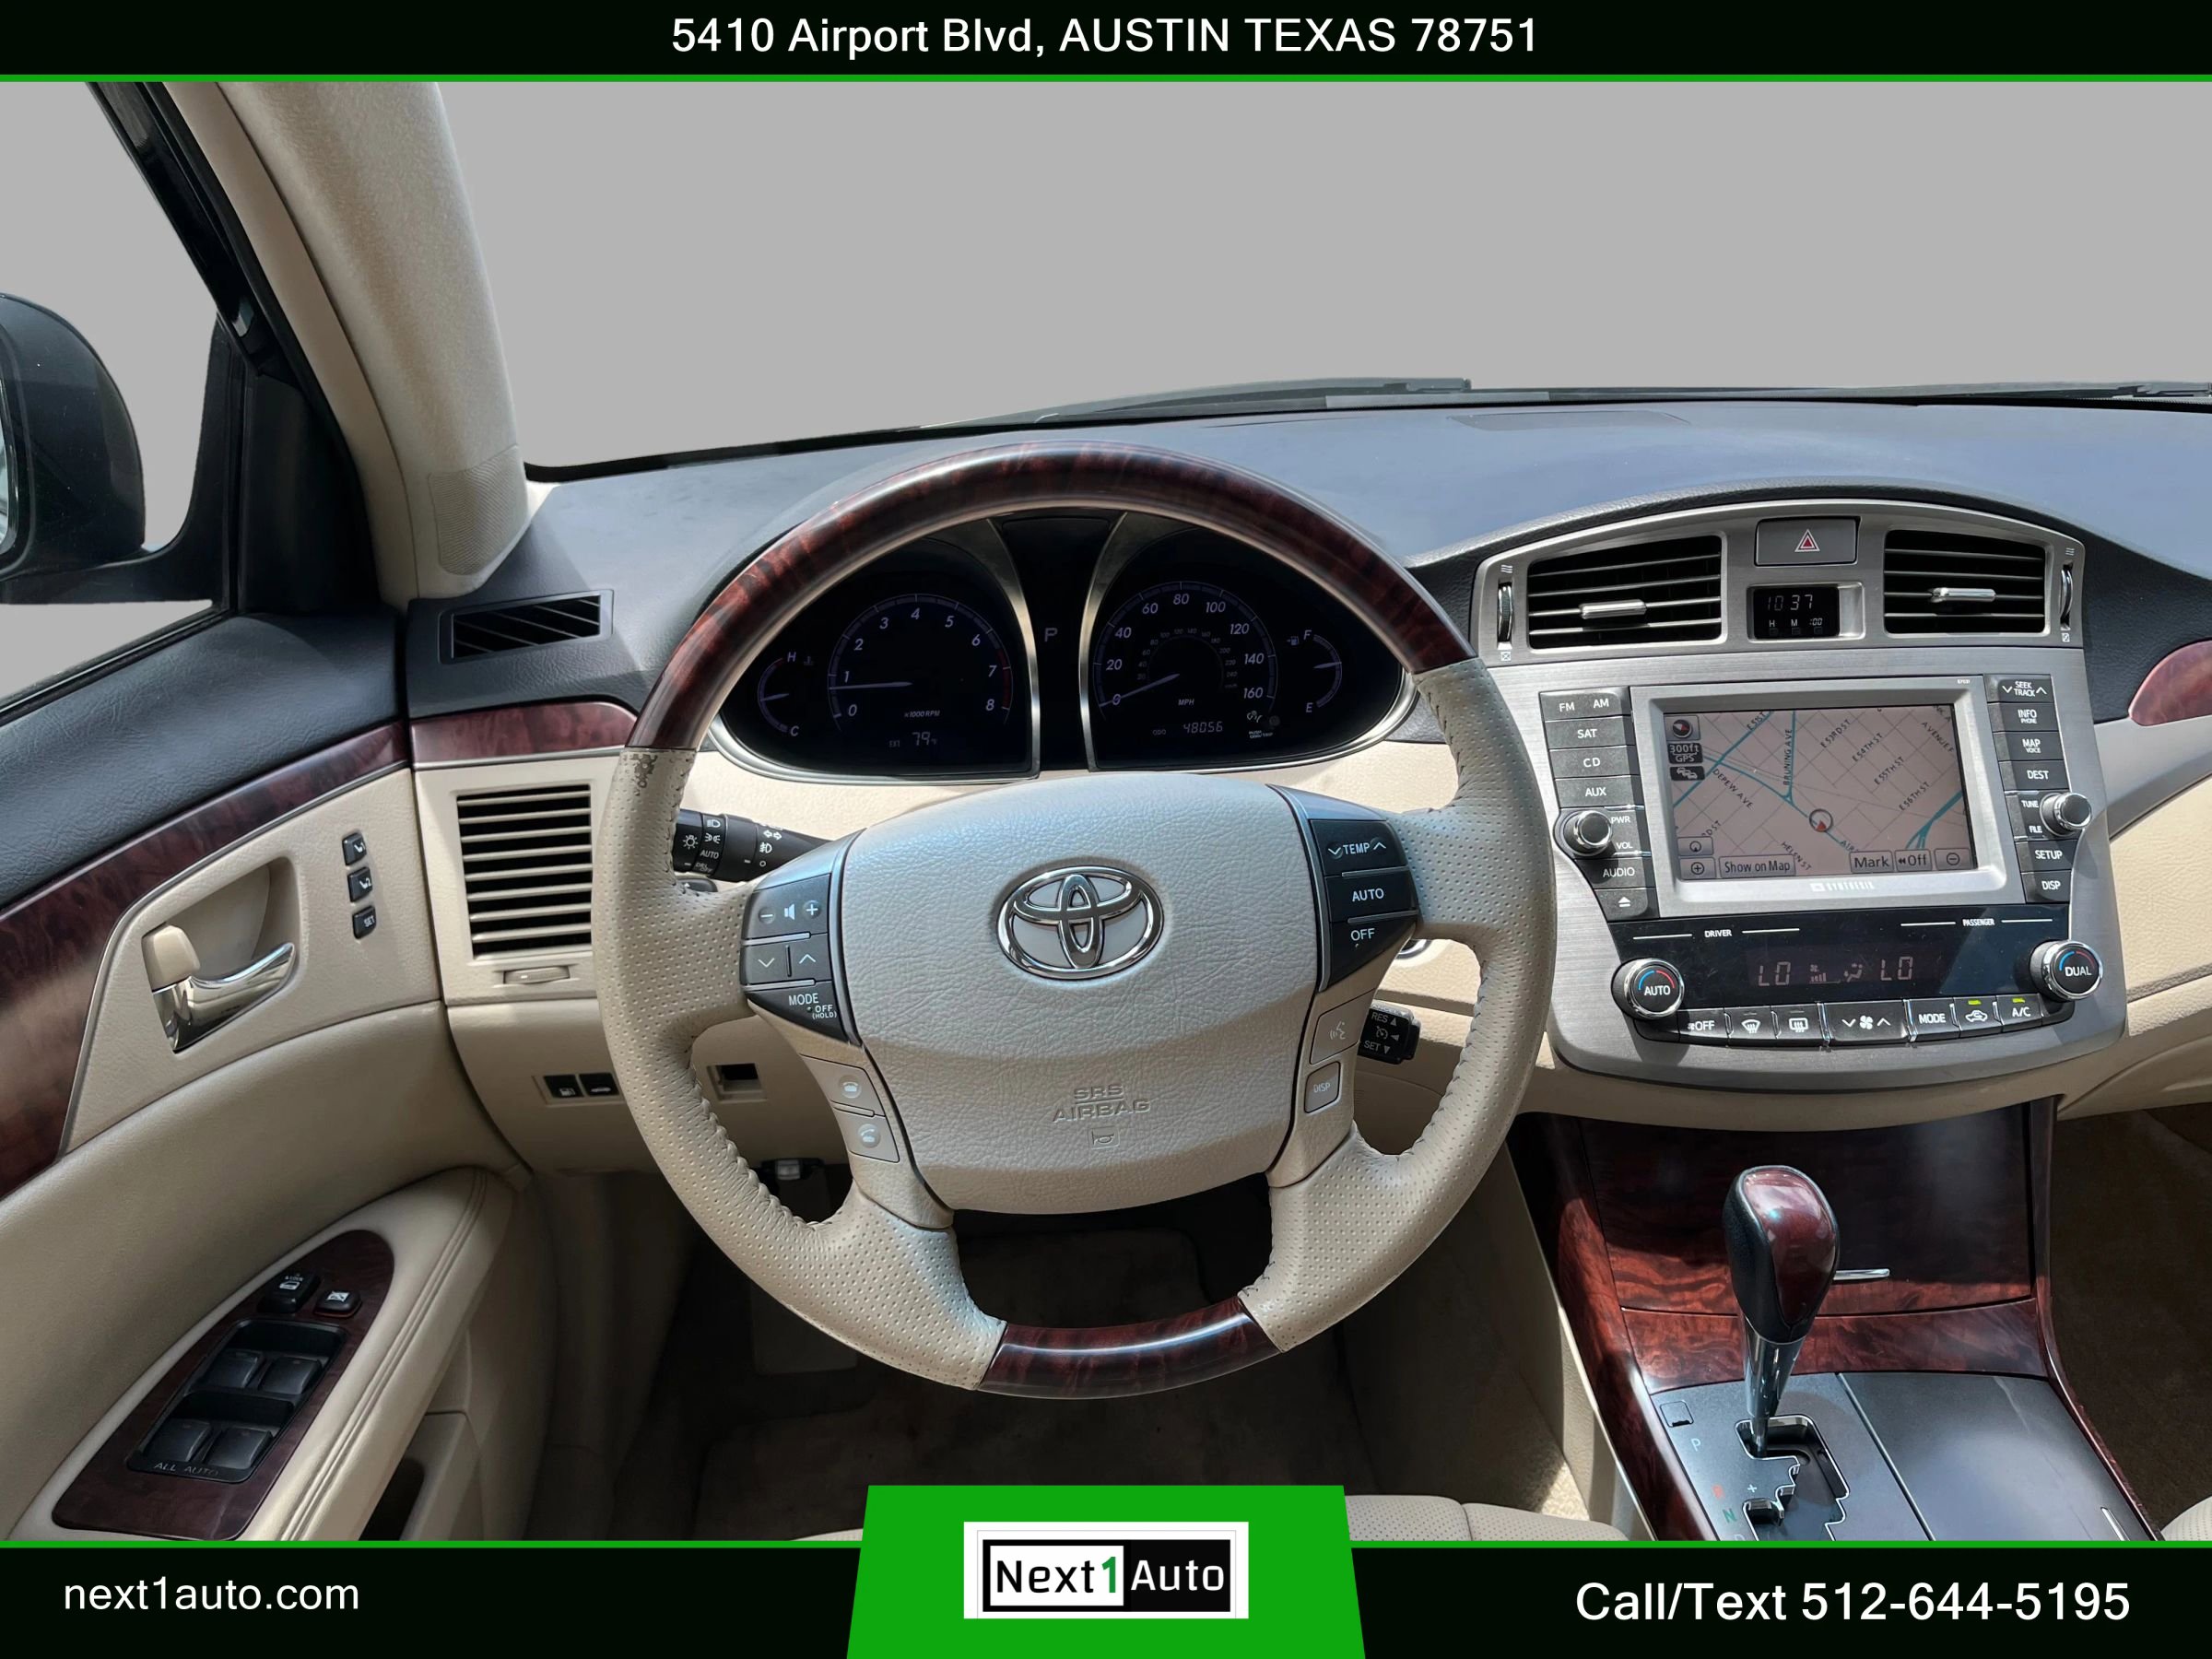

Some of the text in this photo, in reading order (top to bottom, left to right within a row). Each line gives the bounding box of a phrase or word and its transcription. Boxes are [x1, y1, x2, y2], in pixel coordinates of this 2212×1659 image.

[1172, 594, 1190, 606] 80
[1142, 603, 1159, 615] 60
[1206, 601, 1226, 613] 100
[911, 608, 920, 620] 4
[879, 618, 889, 630] 3
[945, 616, 955, 628] 5
[1769, 619, 1775, 628] H
[1790, 618, 1798, 627] M
[1044, 627, 1058, 642] P
[1115, 627, 1132, 639] 40
[1230, 623, 1250, 635] 120
[1303, 629, 1312, 641] F
[854, 639, 864, 651] 2
[971, 634, 982, 646] 6
[787, 652, 796, 663] H
[1244, 653, 1265, 665] 140
[988, 665, 997, 677] 7
[1106, 659, 1123, 671] 20
[843, 671, 850, 683] 1
[1243, 688, 1264, 700] 160
[2014, 688, 2035, 697] TRACK
[985, 699, 995, 712] 8
[1178, 698, 1194, 706] MPH
[1306, 702, 1313, 713] E
[1559, 703, 1575, 712] FM
[1593, 699, 1609, 708] AM
[848, 704, 858, 716] 0
[2018, 709, 2037, 718] INFO
[1182, 721, 1223, 735] 48056
[1841, 719, 1851, 730] ST
[790, 725, 799, 737] C
[1577, 728, 1597, 738] SAT
[1783, 729, 1793, 747] AVE
[2022, 738, 2041, 747] MAP
[1669, 744, 1700, 754] 300ft
[1856, 740, 1874, 759] 54TH
[1873, 732, 1883, 743] ST
[1583, 758, 1601, 768] CD
[1675, 754, 1695, 763] GPS
[1878, 764, 1896, 782] 55TH
[1894, 756, 1904, 767] ST
[2027, 769, 2049, 780] DEST
[1584, 787, 1606, 797] AUX
[1712, 768, 1754, 811] DEPEW AVE
[1903, 789, 1922, 807] 56TH
[1920, 782, 1930, 793] ST
[2021, 799, 2039, 808] TUNE
[1611, 816, 1631, 824] PWR
[2029, 825, 2042, 834] FILE
[1343, 842, 1371, 855] TEMP
[1616, 841, 1633, 850] VOL
[700, 849, 720, 859] AUTO
[1908, 854, 1926, 866] Off
[2035, 850, 2063, 861] SETUP
[1724, 860, 1791, 874] Show on Map
[1800, 861, 1812, 871] ST
[1854, 855, 1889, 868] Mark
[1603, 866, 1635, 877] AUDIO
[2041, 879, 2061, 890] DISP
[1351, 888, 1384, 902] AUTO
[363, 915, 375, 927] SET
[1962, 918, 1995, 927] PASSENGER
[1350, 927, 1375, 941] OFF
[1704, 929, 1733, 938] DRIVER
[1758, 961, 1791, 987] LO
[1880, 956, 1913, 982] LO
[2065, 966, 2092, 977] DUAL
[1643, 984, 1671, 996] AUTO
[788, 993, 819, 1006] MODE
[815, 1004, 833, 1013] OFF
[2012, 1006, 2031, 1018] A/C
[812, 1010, 838, 1020] (HOLD)
[1371, 1011, 1389, 1023] RES
[1919, 1013, 1947, 1025] MODE
[1695, 1019, 1715, 1031] OFF
[1363, 1041, 1381, 1052] SET
[1074, 1083, 1124, 1101] SRS
[1313, 1082, 1331, 1093] DISP
[1052, 1098, 1152, 1124] AIRBAG
[1689, 1438, 1701, 1453] P
[153, 1462, 177, 1472] ALL
[1722, 1508, 1738, 1524] N
